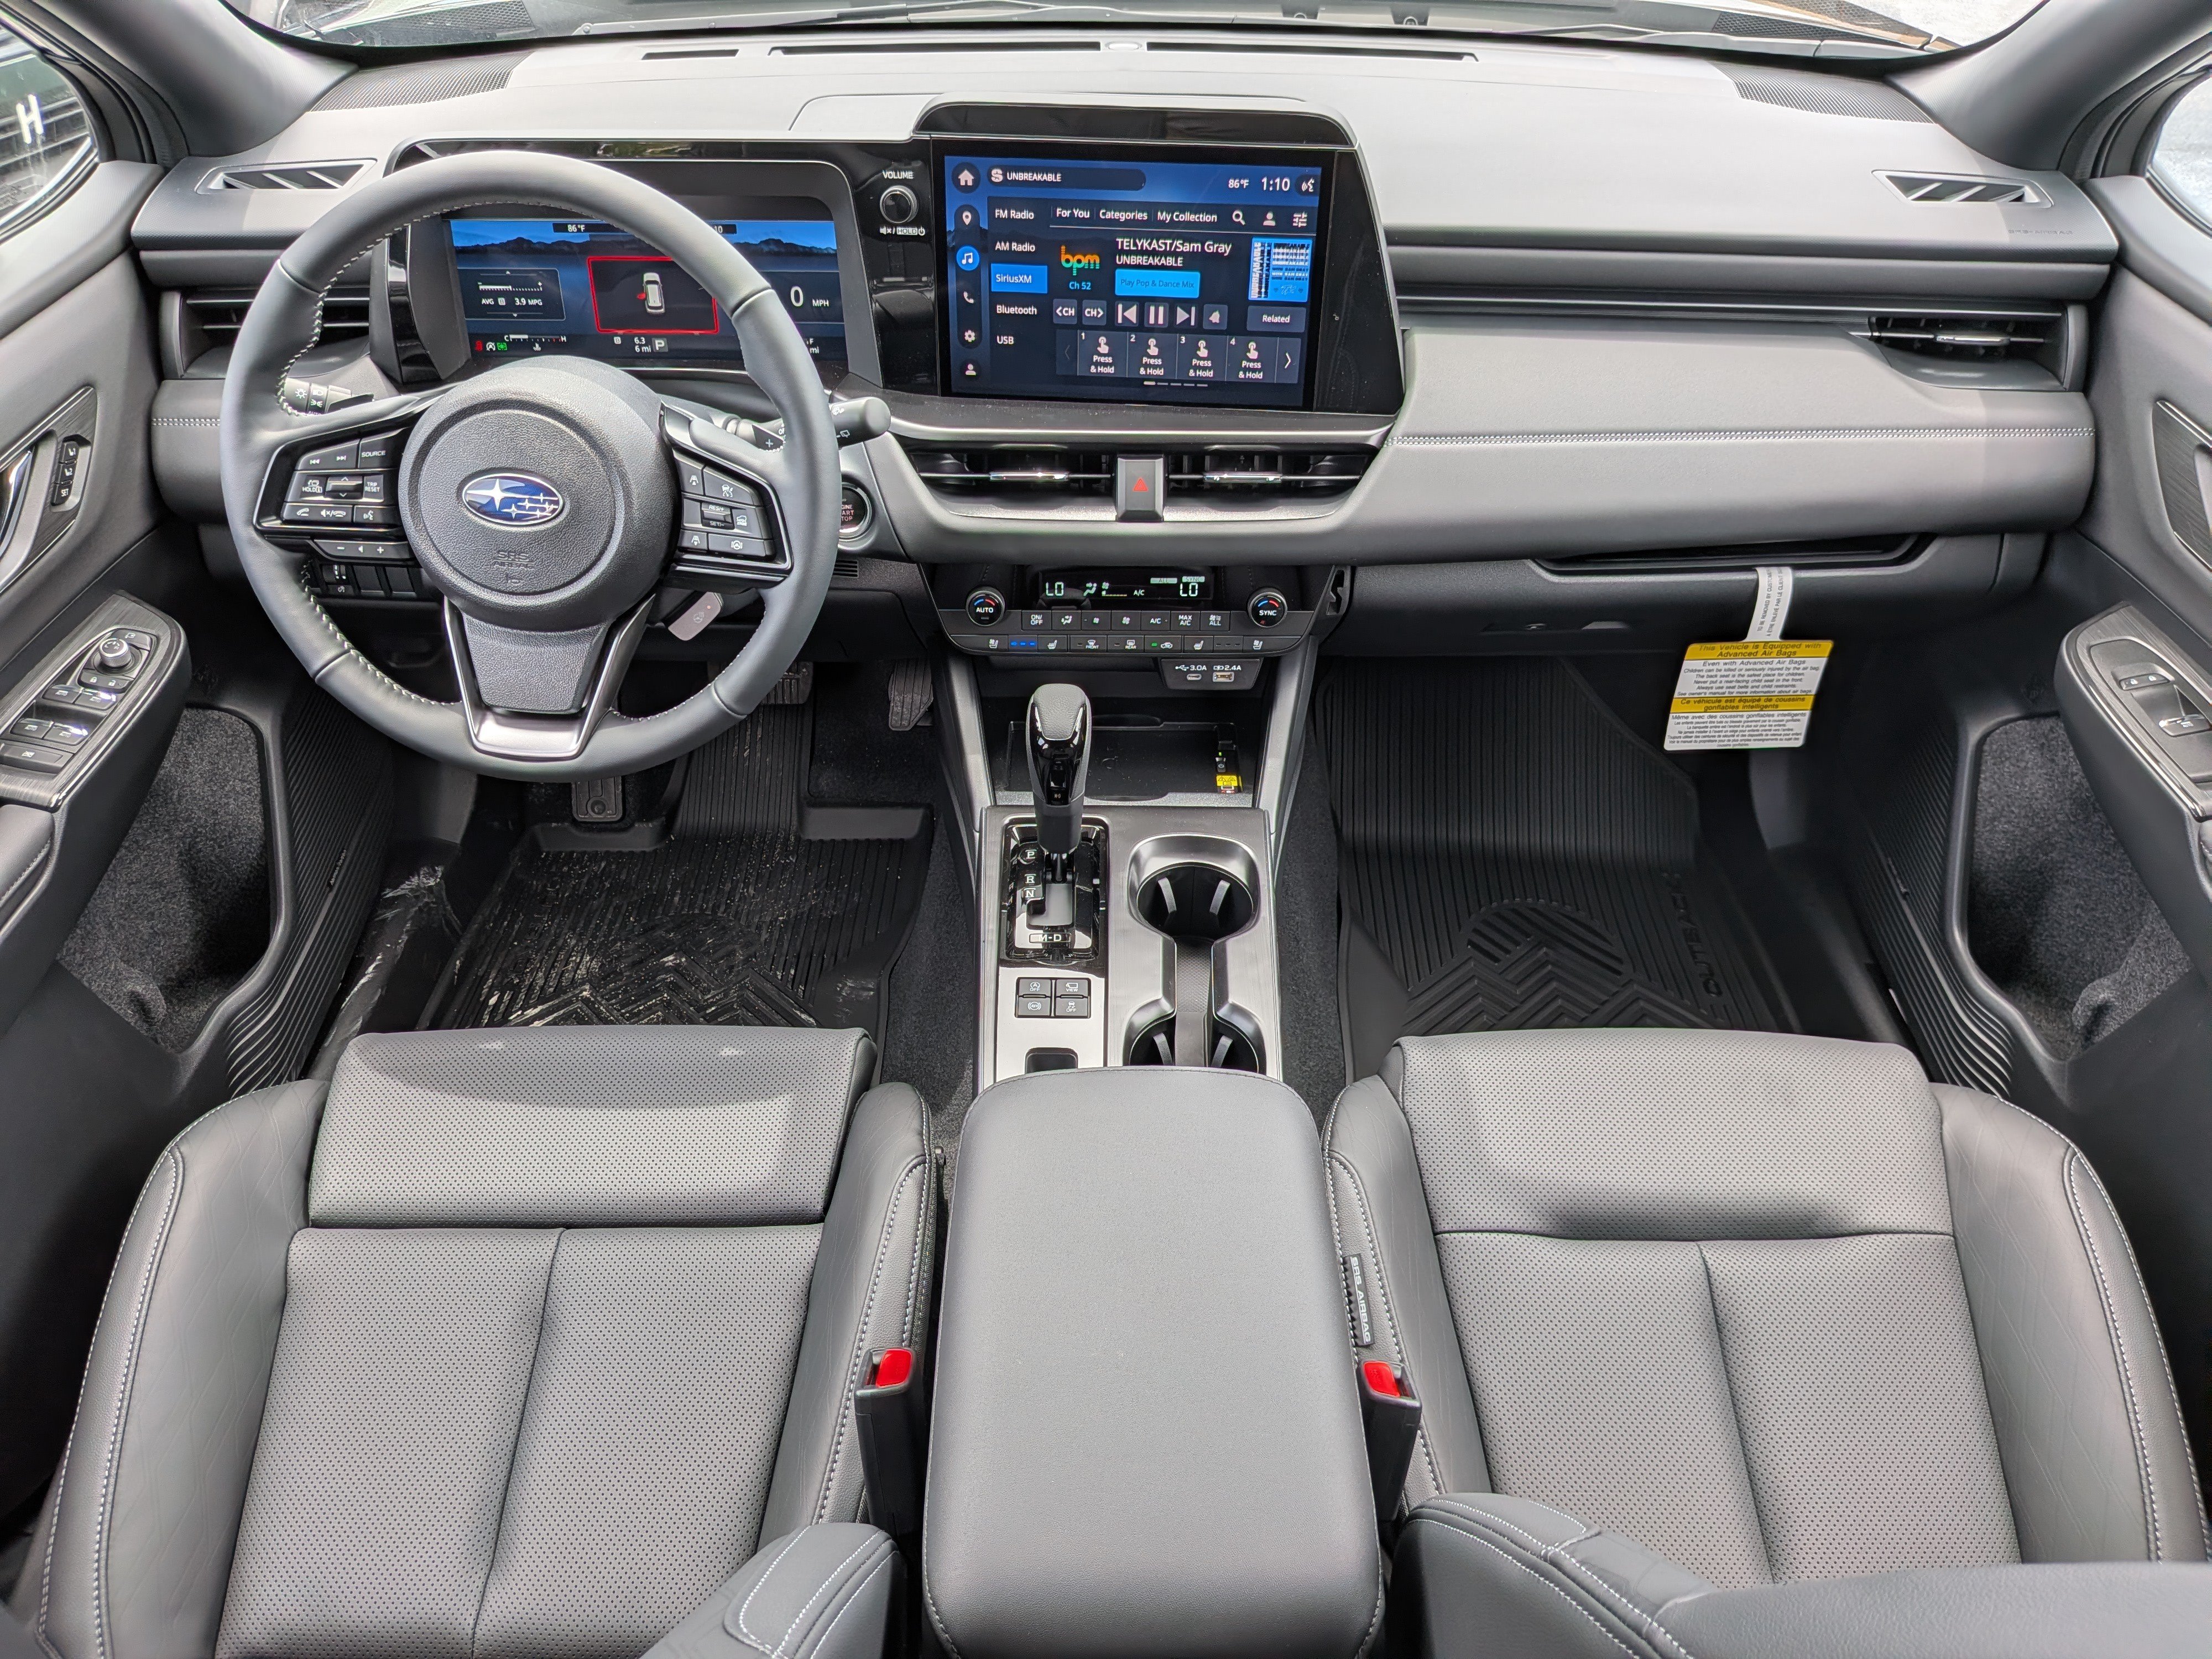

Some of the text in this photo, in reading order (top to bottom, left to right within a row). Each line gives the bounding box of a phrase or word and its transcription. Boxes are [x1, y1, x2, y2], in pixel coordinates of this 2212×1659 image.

[882, 170, 914, 179] VOLUME
[1006, 172, 1062, 182] UNBREAKABLE
[1261, 176, 1290, 191] 1:10
[995, 210, 1034, 220] FM Radio
[1056, 207, 1090, 218] For You
[1099, 210, 1148, 222] Categories
[1157, 210, 1218, 223] My Collection
[995, 242, 1035, 252] AM Radio
[1204, 241, 1232, 257] Gray
[1061, 245, 1100, 276] bpm
[1116, 254, 1183, 267] UNBREAKABLE
[996, 274, 1032, 284] SiriusXM
[1121, 279, 1135, 288] Play
[1136, 279, 1150, 289] Pop
[1159, 280, 1180, 288] Dance
[1182, 280, 1194, 289] Mix
[1069, 281, 1092, 290] Ch 52
[790, 286, 830, 307] 0 MPH
[514, 298, 526, 306] 3.9
[997, 305, 1037, 315] Bluetooth
[1262, 314, 1290, 324] Related
[655, 339, 665, 350] P
[997, 336, 1014, 345] USB
[1142, 357, 1162, 365] Press
[1242, 361, 1261, 369] Press
[1097, 366, 1114, 374] Hold
[1147, 367, 1164, 375] Hold
[1246, 371, 1263, 379] Hold
[497, 551, 529, 562] SRS
[1762, 642, 1802, 651] Equipped
[1776, 650, 1797, 658] Bags
[1026, 850, 1036, 859] P
[1026, 875, 1036, 884] R
[1025, 890, 1035, 898] N
[1351, 1256, 1371, 1343] SRS AIRBAG
